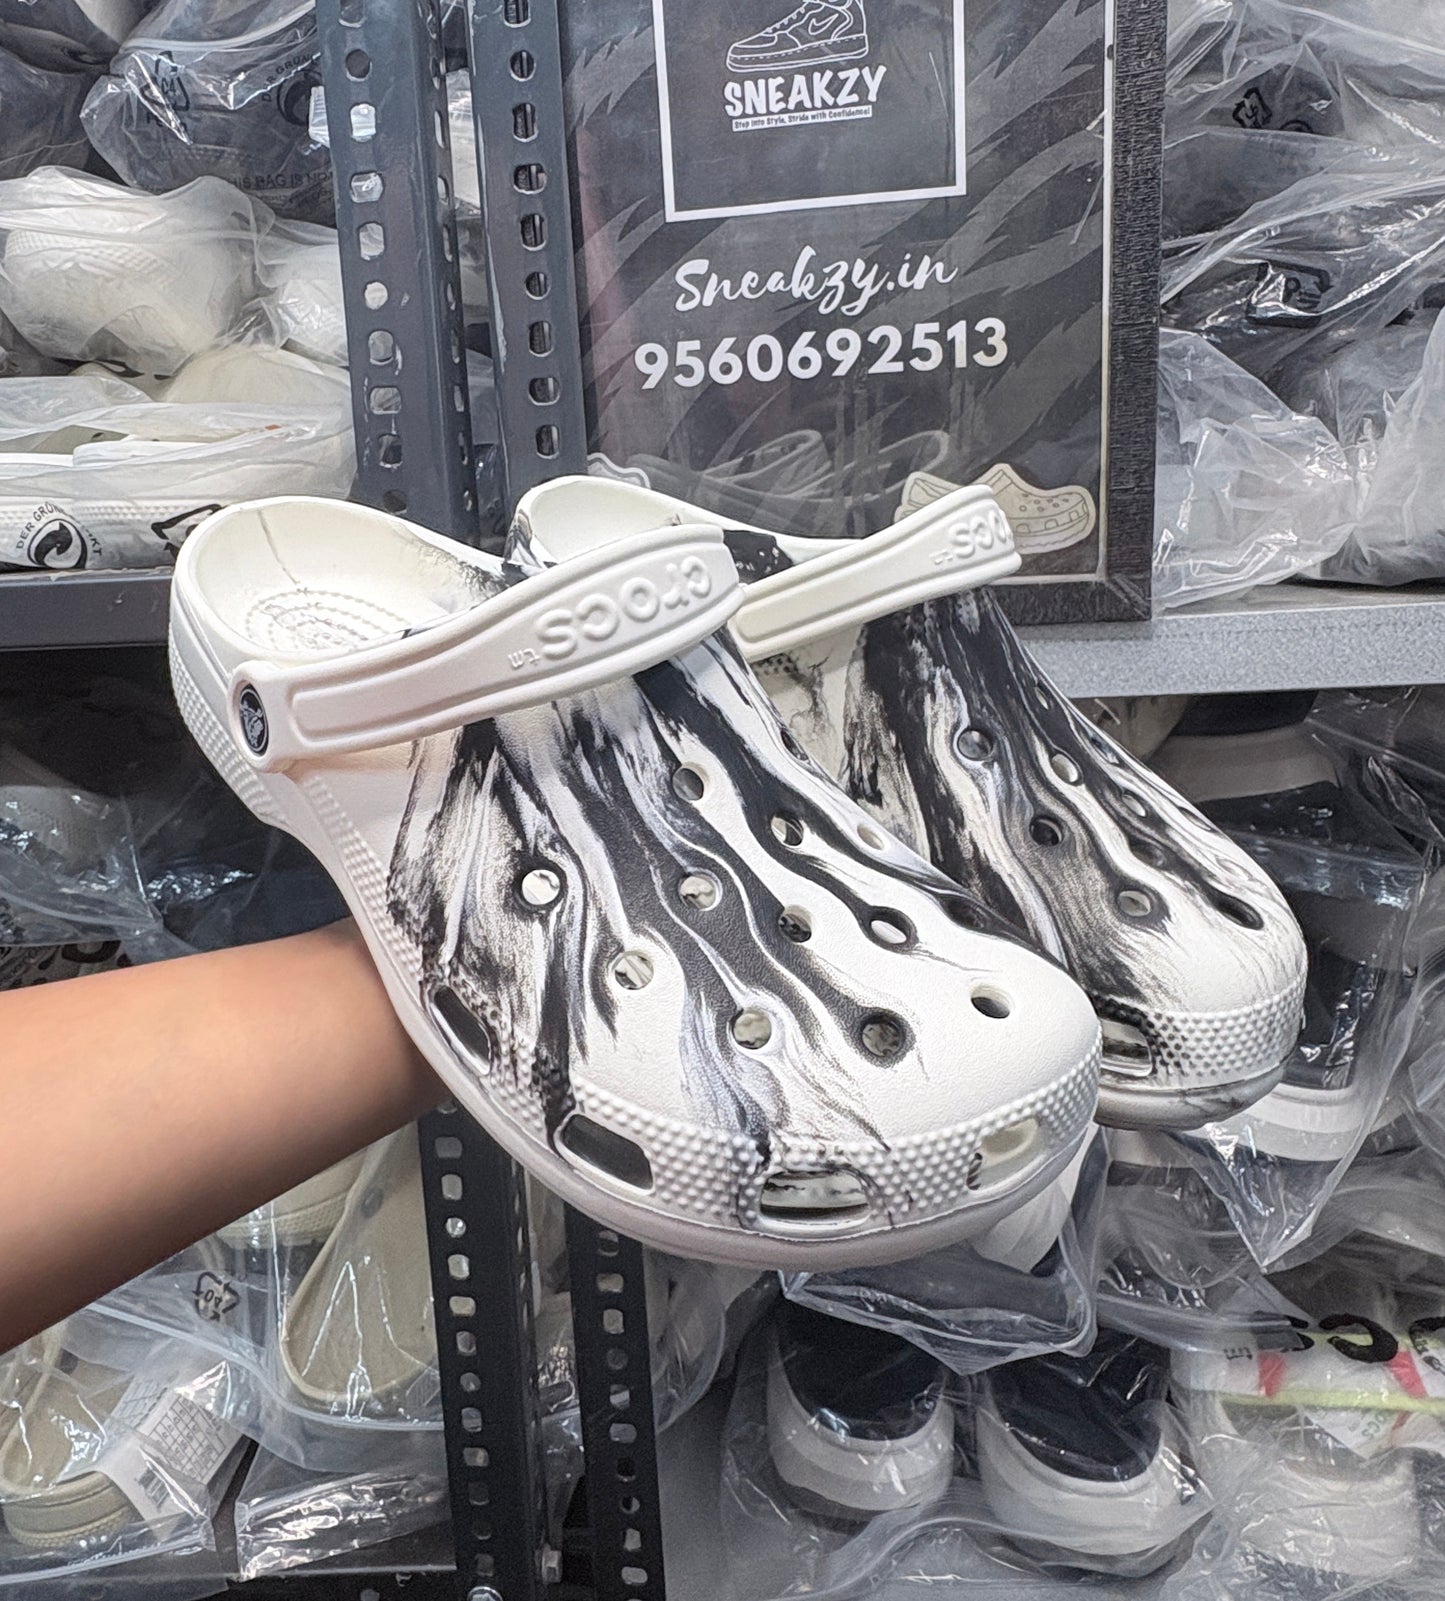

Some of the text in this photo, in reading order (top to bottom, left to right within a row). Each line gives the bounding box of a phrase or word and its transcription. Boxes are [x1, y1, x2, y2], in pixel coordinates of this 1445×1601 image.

[724, 65, 887, 117] SNEAKZY
[810, 111, 827, 120] with
[255, 174, 287, 190] BAG
[674, 245, 958, 316] Sneakzy.in
[634, 317, 1009, 390] 9560692513
[16, 522, 36, 550] DER
[535, 555, 713, 661] crocs
